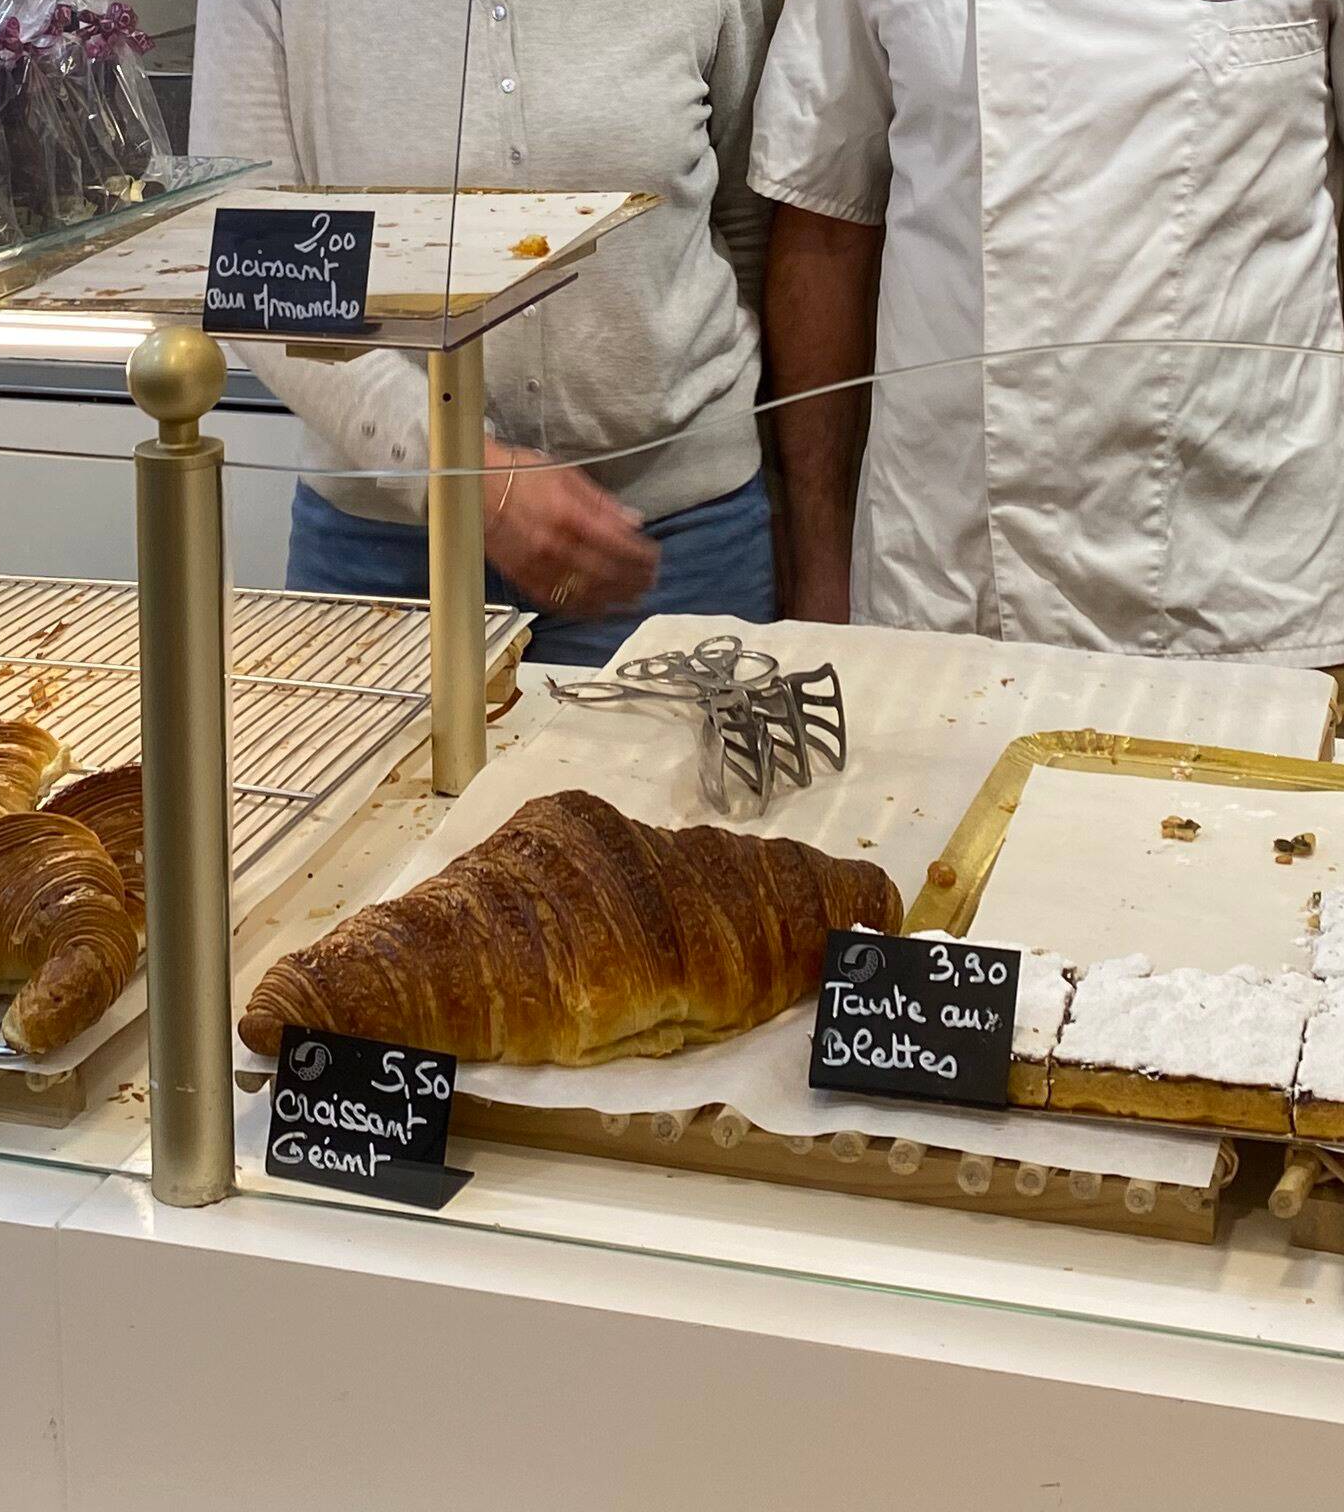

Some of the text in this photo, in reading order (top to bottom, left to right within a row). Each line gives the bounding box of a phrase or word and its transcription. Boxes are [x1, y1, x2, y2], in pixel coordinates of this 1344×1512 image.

[294, 213, 356, 258] 2,00
[929, 944, 1007, 988] 3,90
[371, 1051, 450, 1100] 5,50
